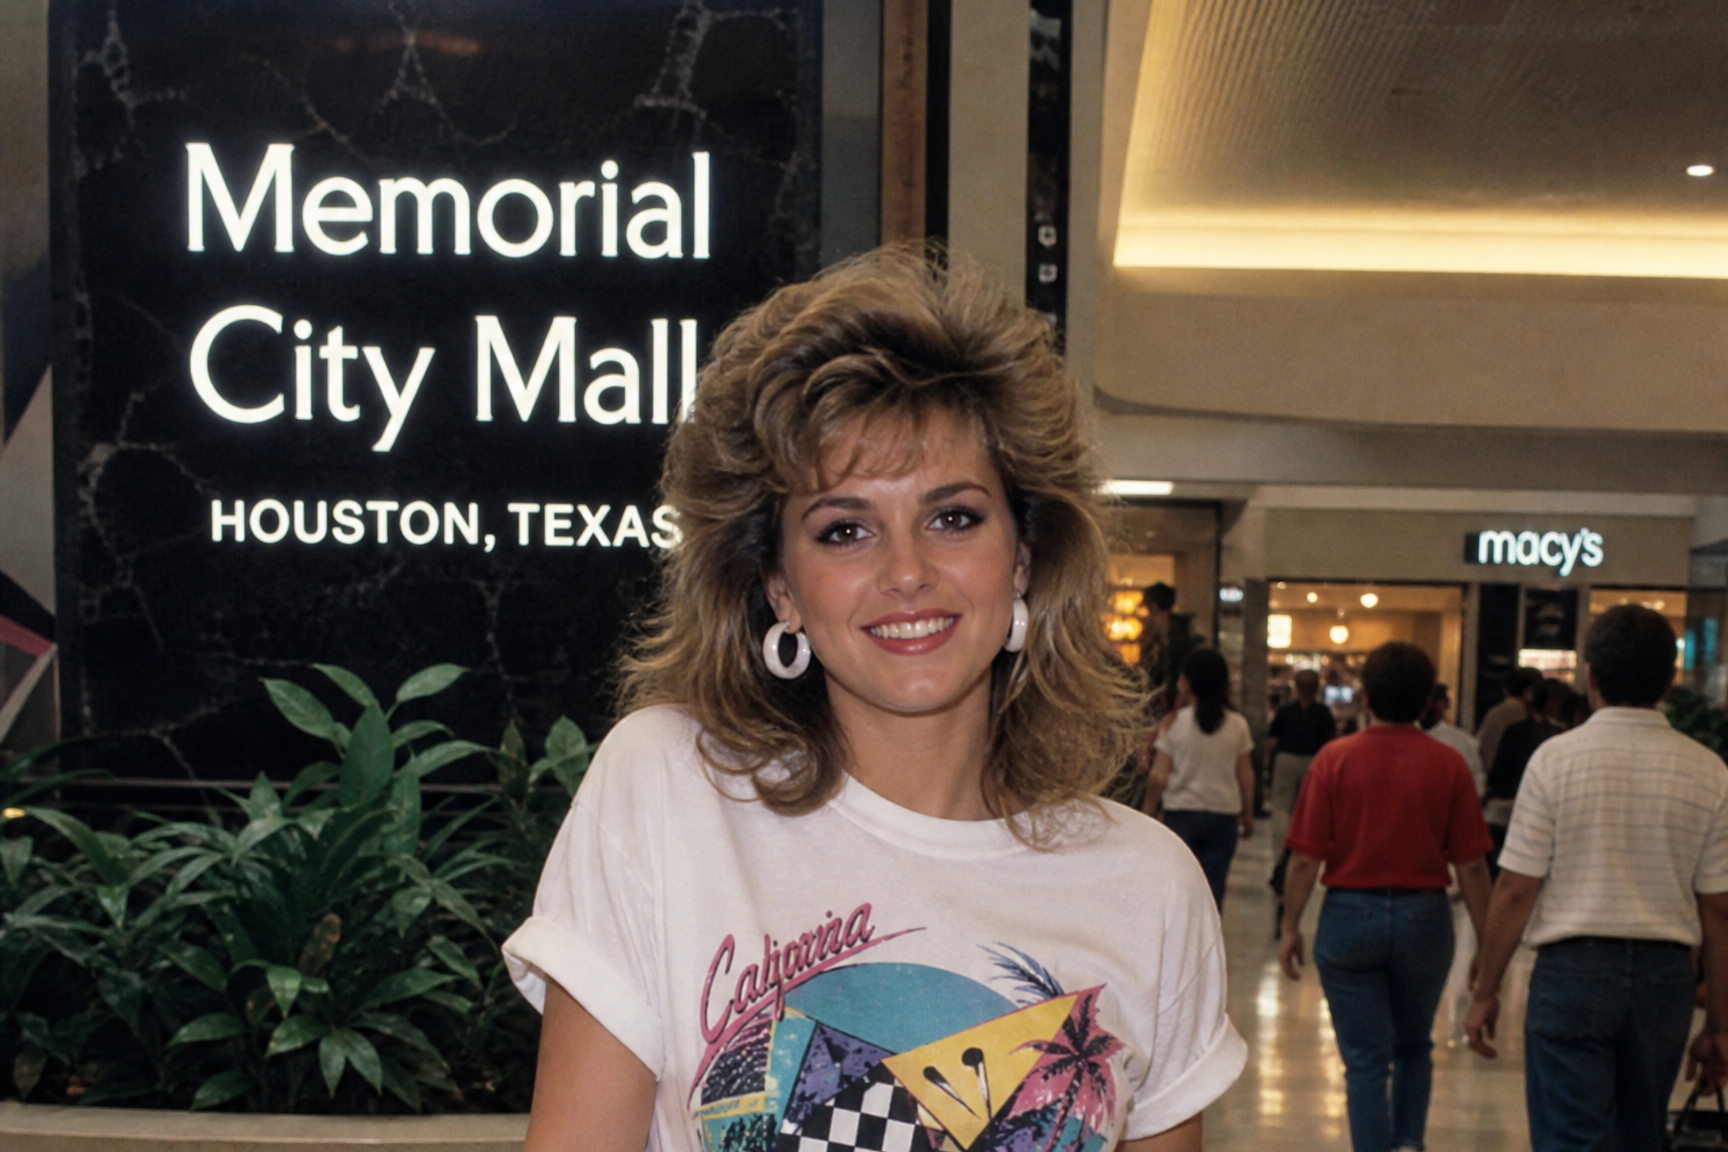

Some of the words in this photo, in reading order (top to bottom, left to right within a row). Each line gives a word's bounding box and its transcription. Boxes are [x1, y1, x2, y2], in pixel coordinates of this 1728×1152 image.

[185, 143, 710, 259] Memorial
[189, 305, 436, 453] City
[475, 315, 699, 424] Mall
[211, 499, 496, 553] HOUSTON,
[507, 503, 685, 550] TEXAS
[1478, 527, 1604, 577] macy's
